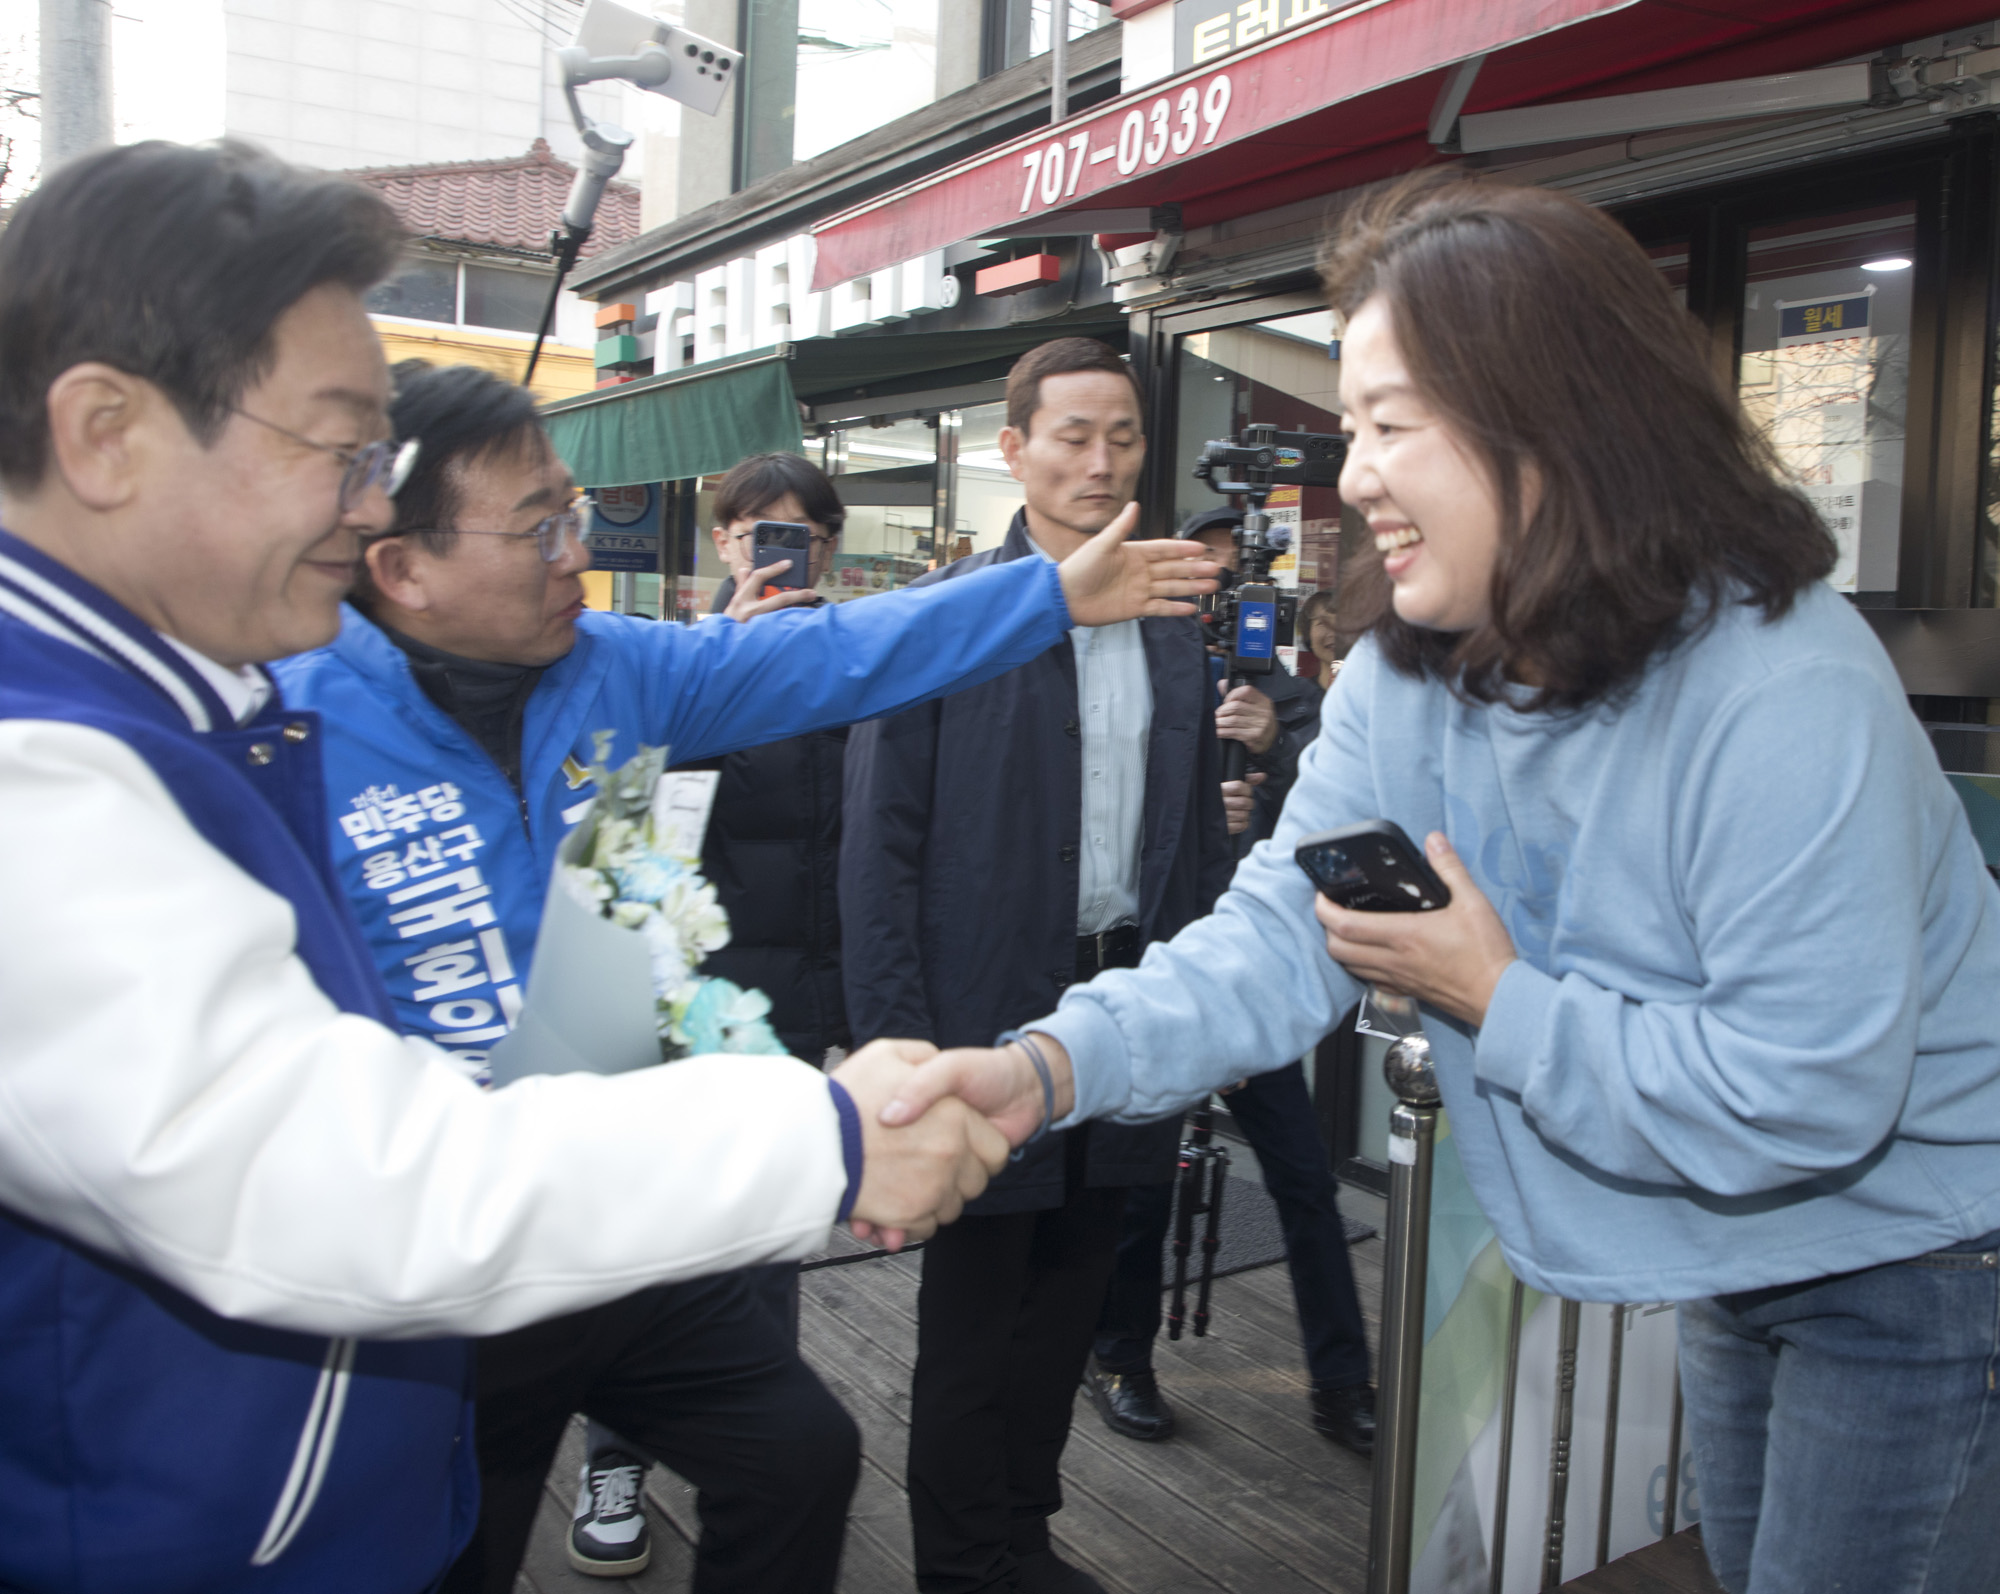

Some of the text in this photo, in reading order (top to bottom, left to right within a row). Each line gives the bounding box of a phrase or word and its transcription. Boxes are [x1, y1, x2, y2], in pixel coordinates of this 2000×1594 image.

[1018, 74, 1232, 213] 707-0339
[1802, 304, 1844, 333] 월세
[338, 781, 467, 851] 민주당
[362, 823, 486, 890] 용산구
